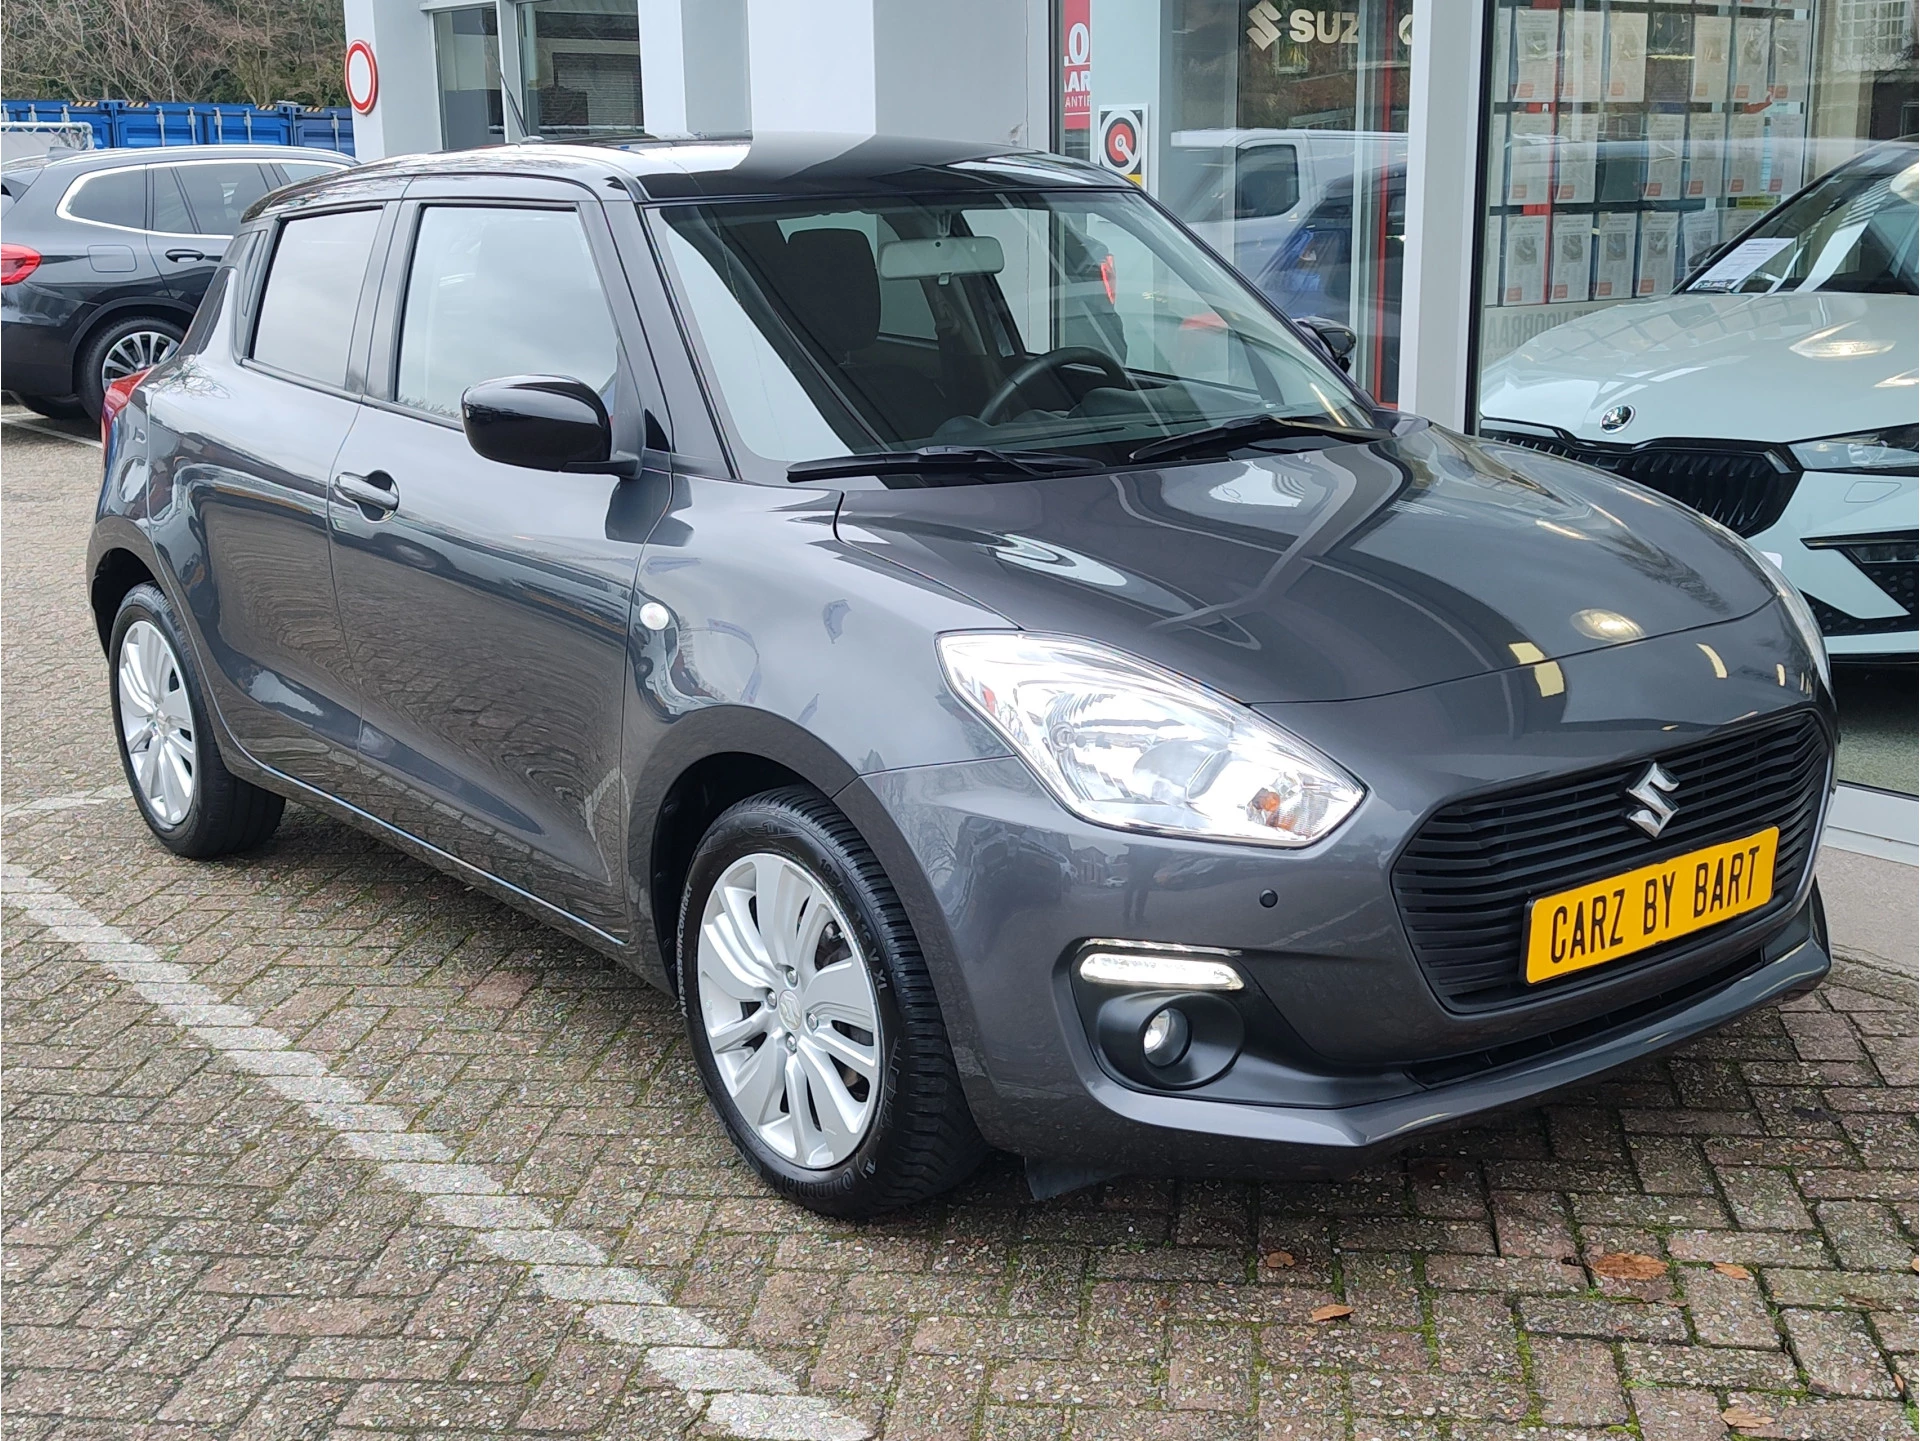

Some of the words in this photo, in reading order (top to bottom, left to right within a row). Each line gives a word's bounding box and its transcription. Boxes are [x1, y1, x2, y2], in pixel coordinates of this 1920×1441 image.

[1550, 888, 1625, 964] CARZ
[1643, 871, 1676, 936] BY
[1693, 845, 1761, 919] BART
[873, 968, 888, 995] XL
